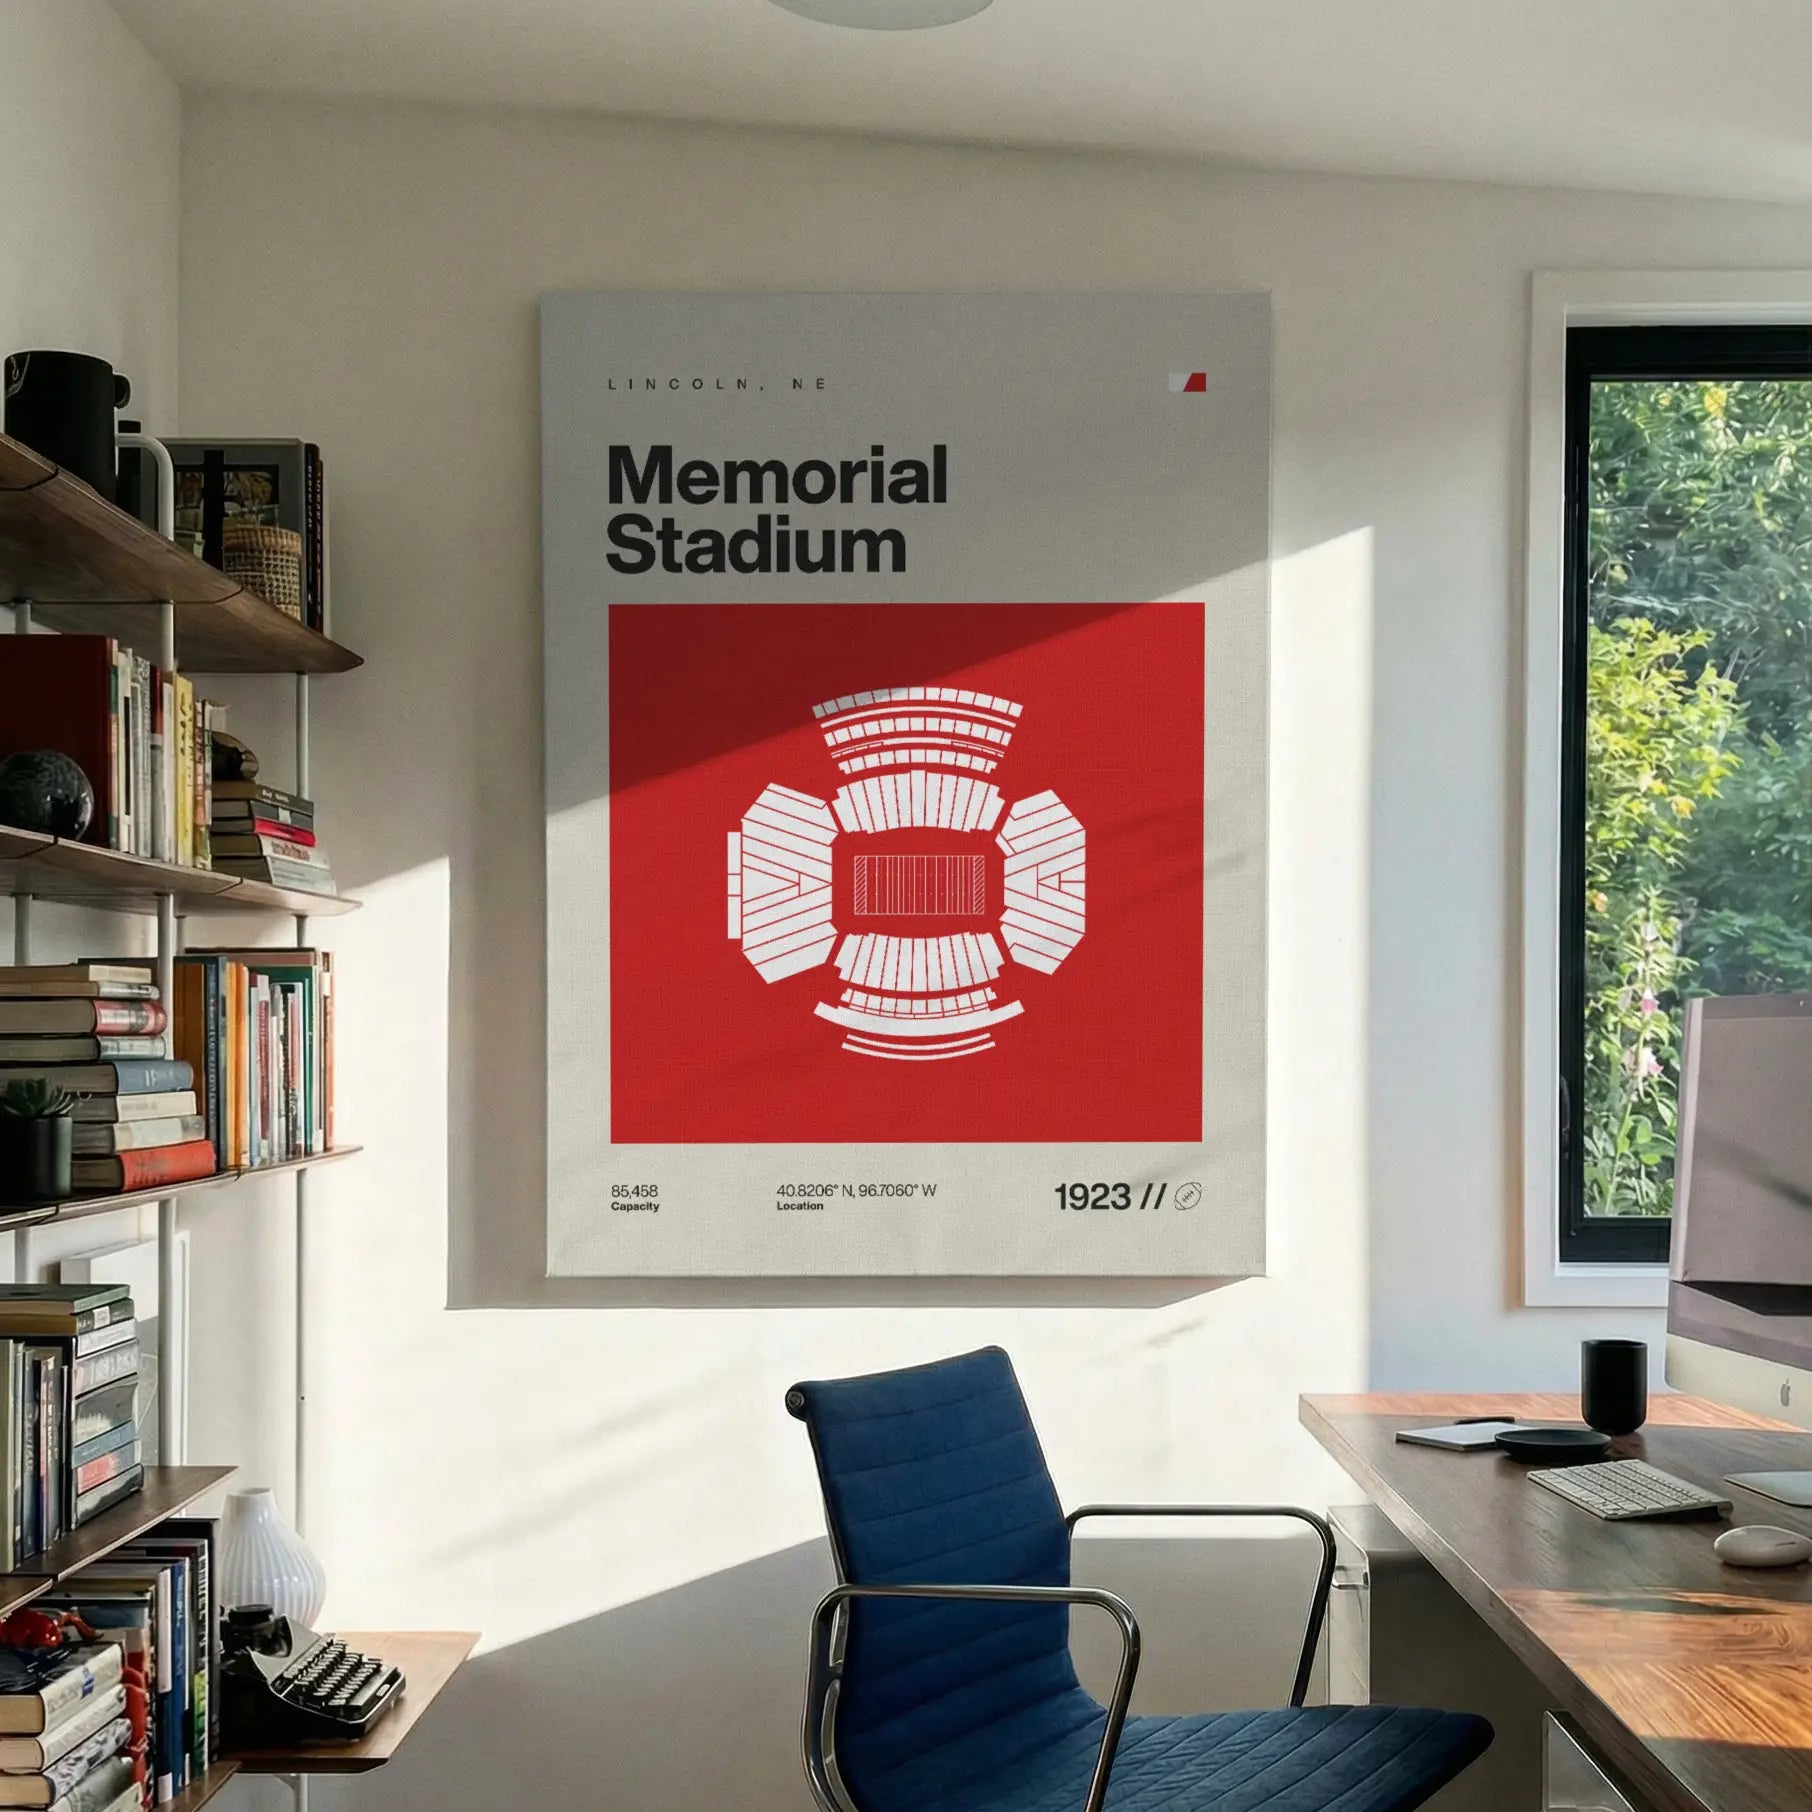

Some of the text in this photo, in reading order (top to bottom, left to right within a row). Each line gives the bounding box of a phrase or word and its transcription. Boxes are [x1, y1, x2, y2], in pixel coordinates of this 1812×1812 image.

[608, 377, 826, 392] LINCOLN, NE
[608, 444, 947, 505] Memorial
[605, 513, 906, 575] Stadium
[611, 1184, 659, 1199] 85,458
[776, 1183, 937, 1199] 40.8206° N, 96.7060° W
[1054, 1182, 1132, 1211] 1923
[610, 1201, 661, 1213] Capacity
[776, 1200, 824, 1211] Location
